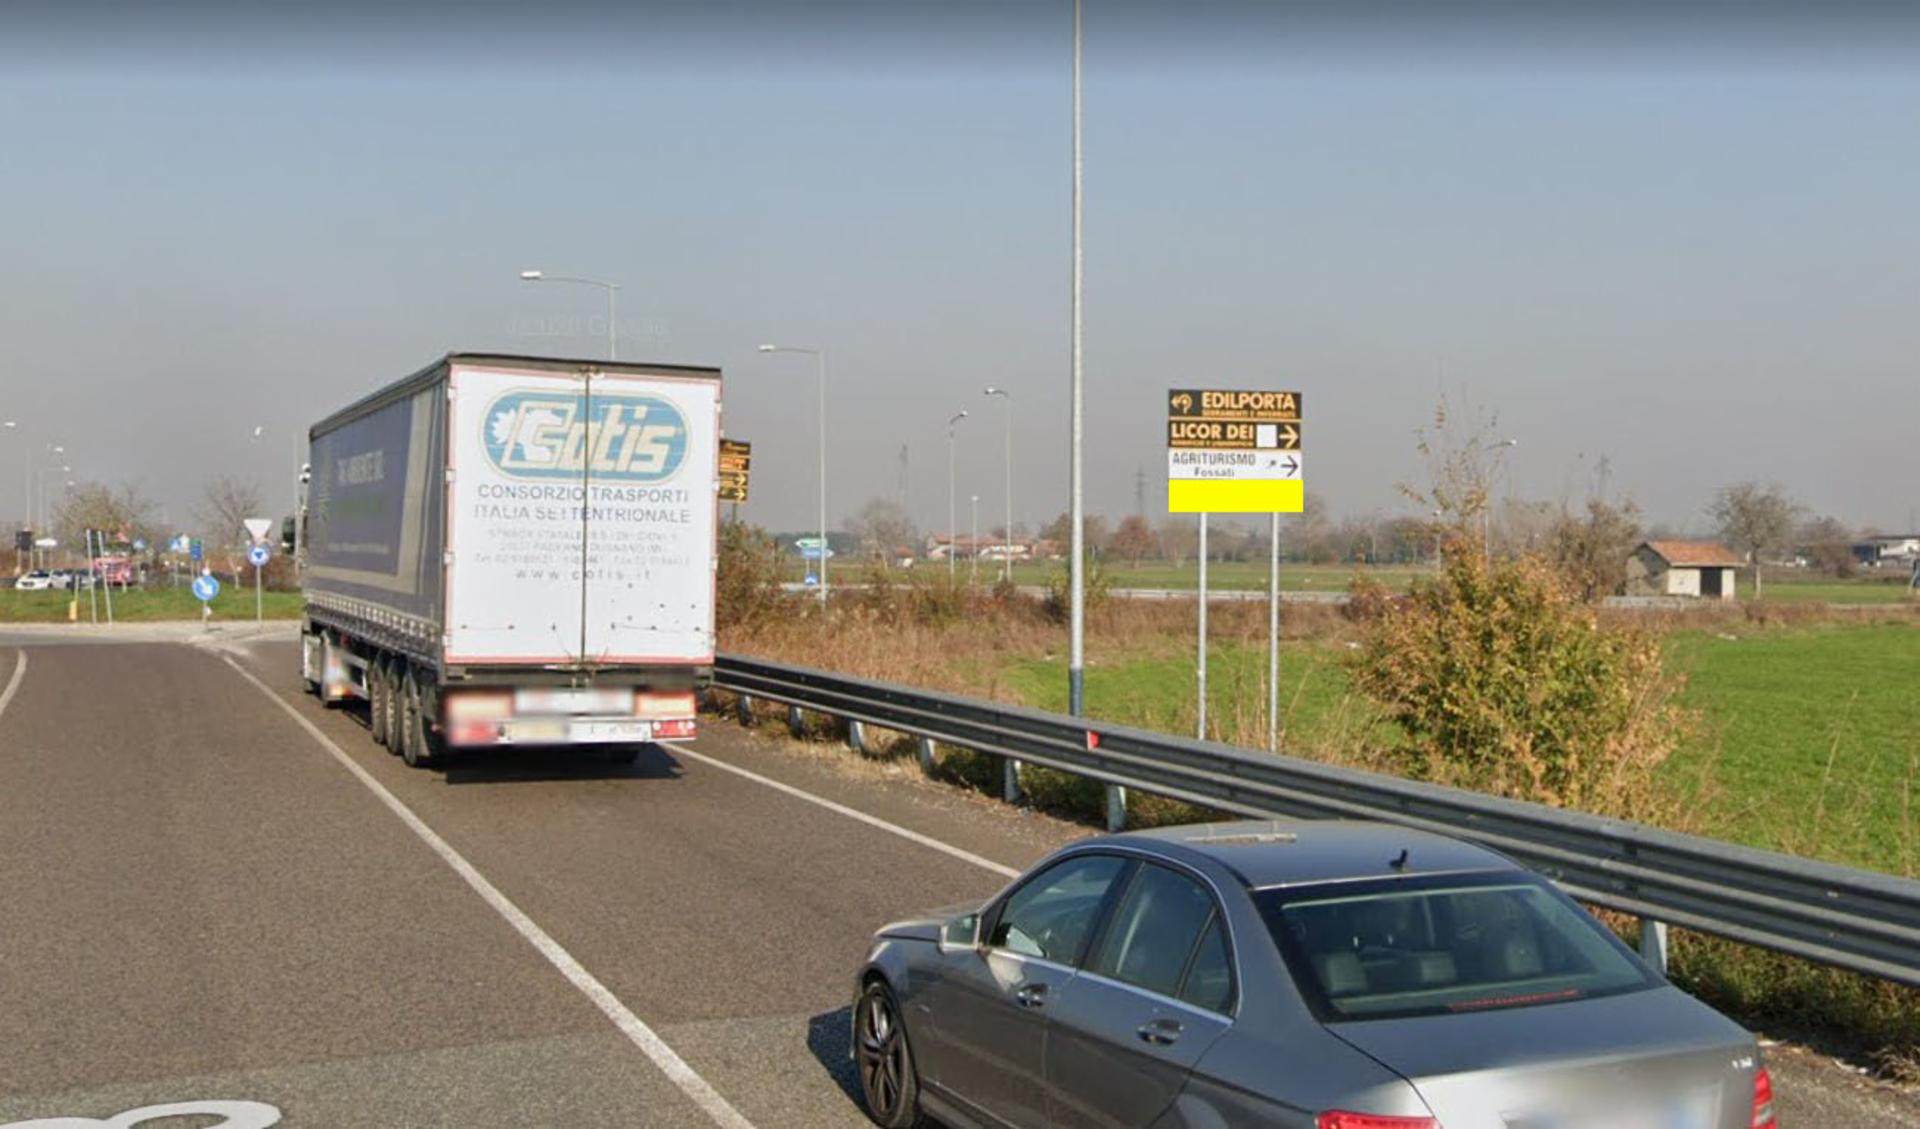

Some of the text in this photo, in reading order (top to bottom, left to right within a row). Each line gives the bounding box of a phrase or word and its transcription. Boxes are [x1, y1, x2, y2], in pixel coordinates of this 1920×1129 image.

[1202, 392, 1296, 410] EDILPORTA
[1171, 423, 1254, 439] LICOR DEI
[1172, 452, 1256, 465] AGRITURISMO
[1194, 466, 1234, 477] Fossati
[478, 484, 689, 503] CONSORZIO TRASPORTI
[474, 504, 692, 523] ITALIA SETTENTRIONALE
